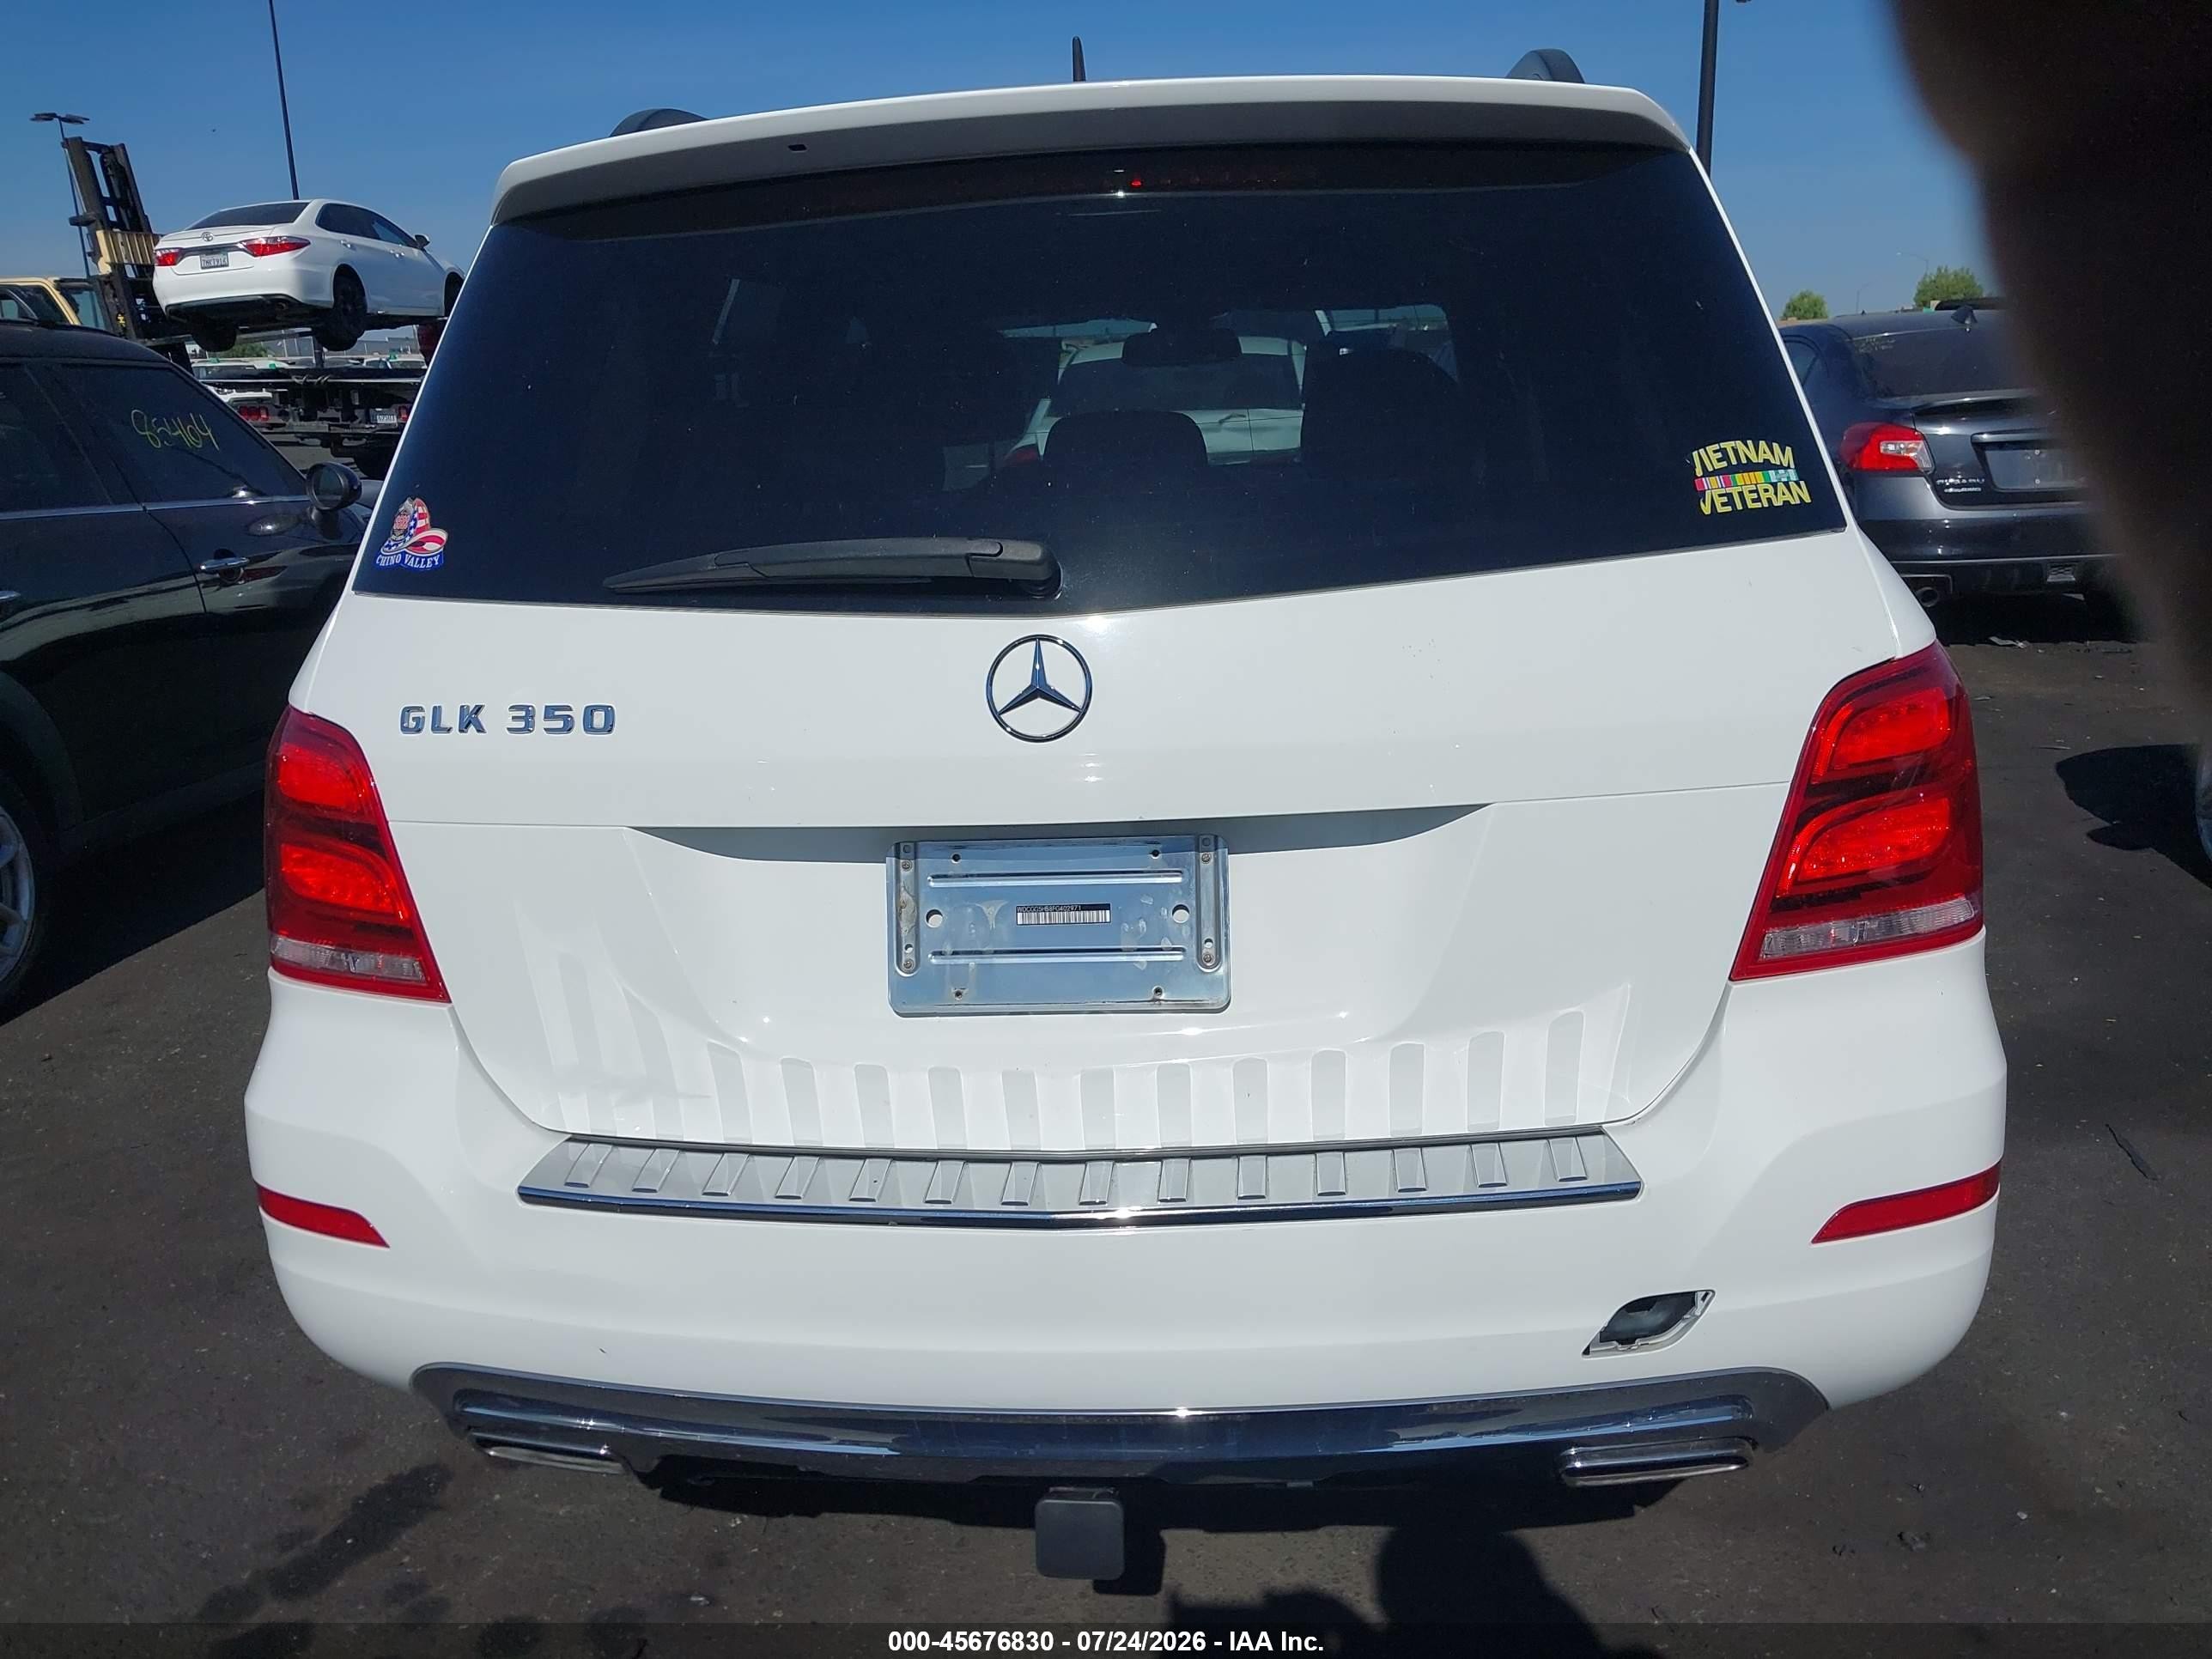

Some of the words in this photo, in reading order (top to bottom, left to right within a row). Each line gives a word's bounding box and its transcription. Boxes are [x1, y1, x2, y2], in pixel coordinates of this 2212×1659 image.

[1692, 440, 1795, 477] VIETNAM
[1700, 480, 1812, 514] VETERAN
[376, 554, 402, 567] CHINO
[404, 554, 441, 568] VALLEY
[400, 704, 488, 734] GLK
[506, 704, 616, 735] 350
